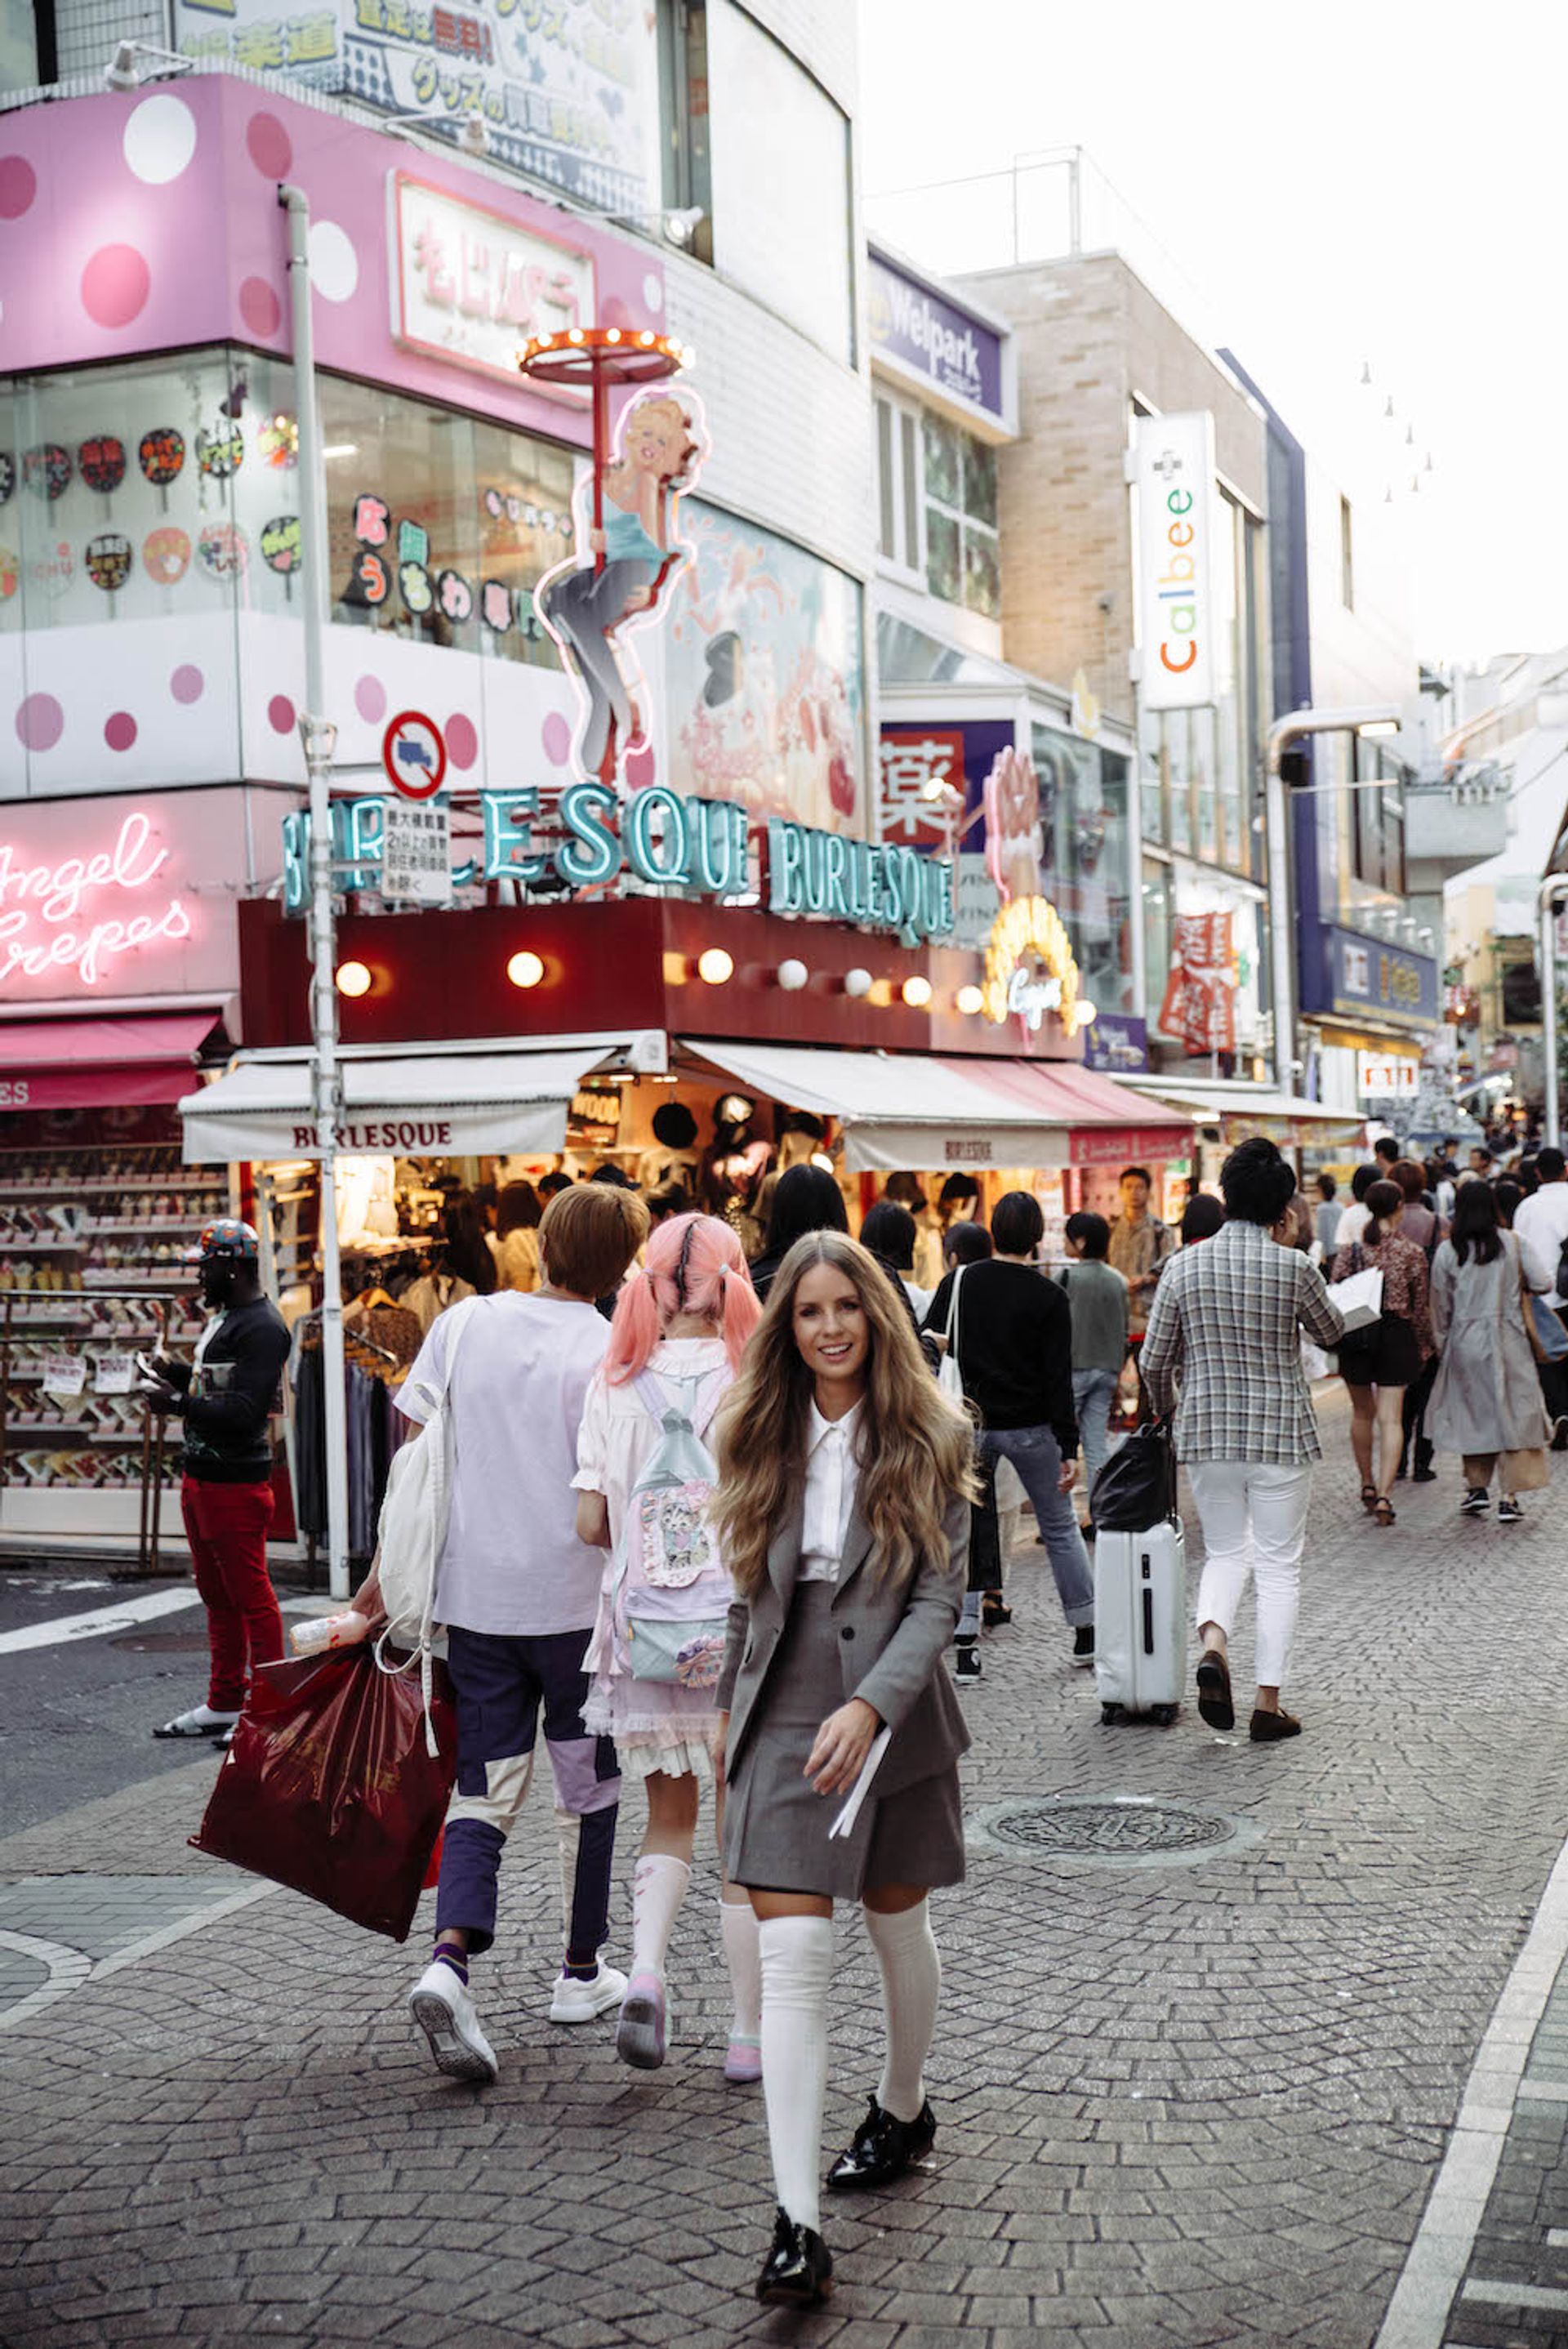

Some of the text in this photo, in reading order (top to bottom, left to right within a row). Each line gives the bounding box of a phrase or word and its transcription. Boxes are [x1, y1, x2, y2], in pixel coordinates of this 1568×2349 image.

[889, 278, 982, 381] Welpark
[880, 738, 956, 836] 薬
[283, 782, 749, 917] BRESQUE
[771, 816, 956, 949] BURLESQUE
